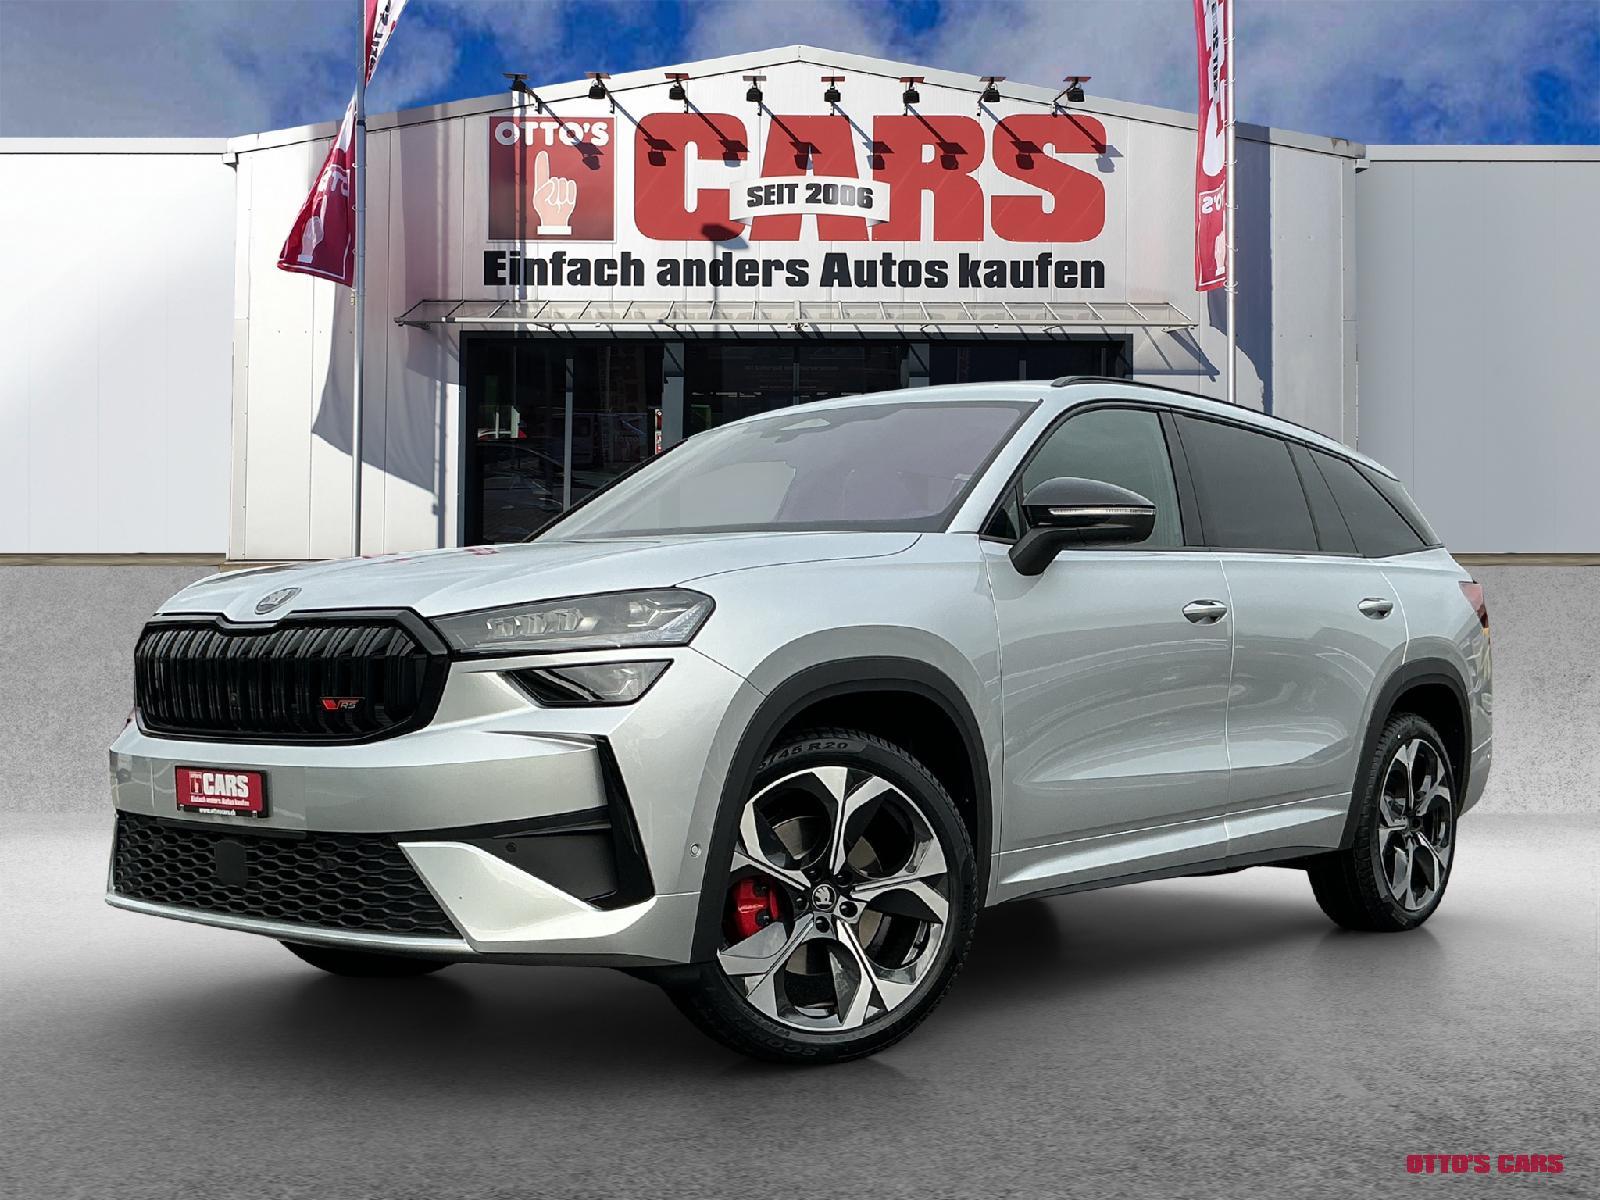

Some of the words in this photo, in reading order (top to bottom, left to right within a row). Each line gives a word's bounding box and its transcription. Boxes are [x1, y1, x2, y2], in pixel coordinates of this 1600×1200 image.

[494, 121, 610, 146] OTTO'S
[634, 112, 1107, 242] CARS
[746, 184, 801, 208] SEIT
[804, 183, 874, 210] 2006
[483, 251, 645, 287] Einfach
[656, 251, 810, 288] anders
[820, 252, 949, 288] Autos
[958, 252, 1105, 288] kaufen
[202, 772, 249, 798] CARS
